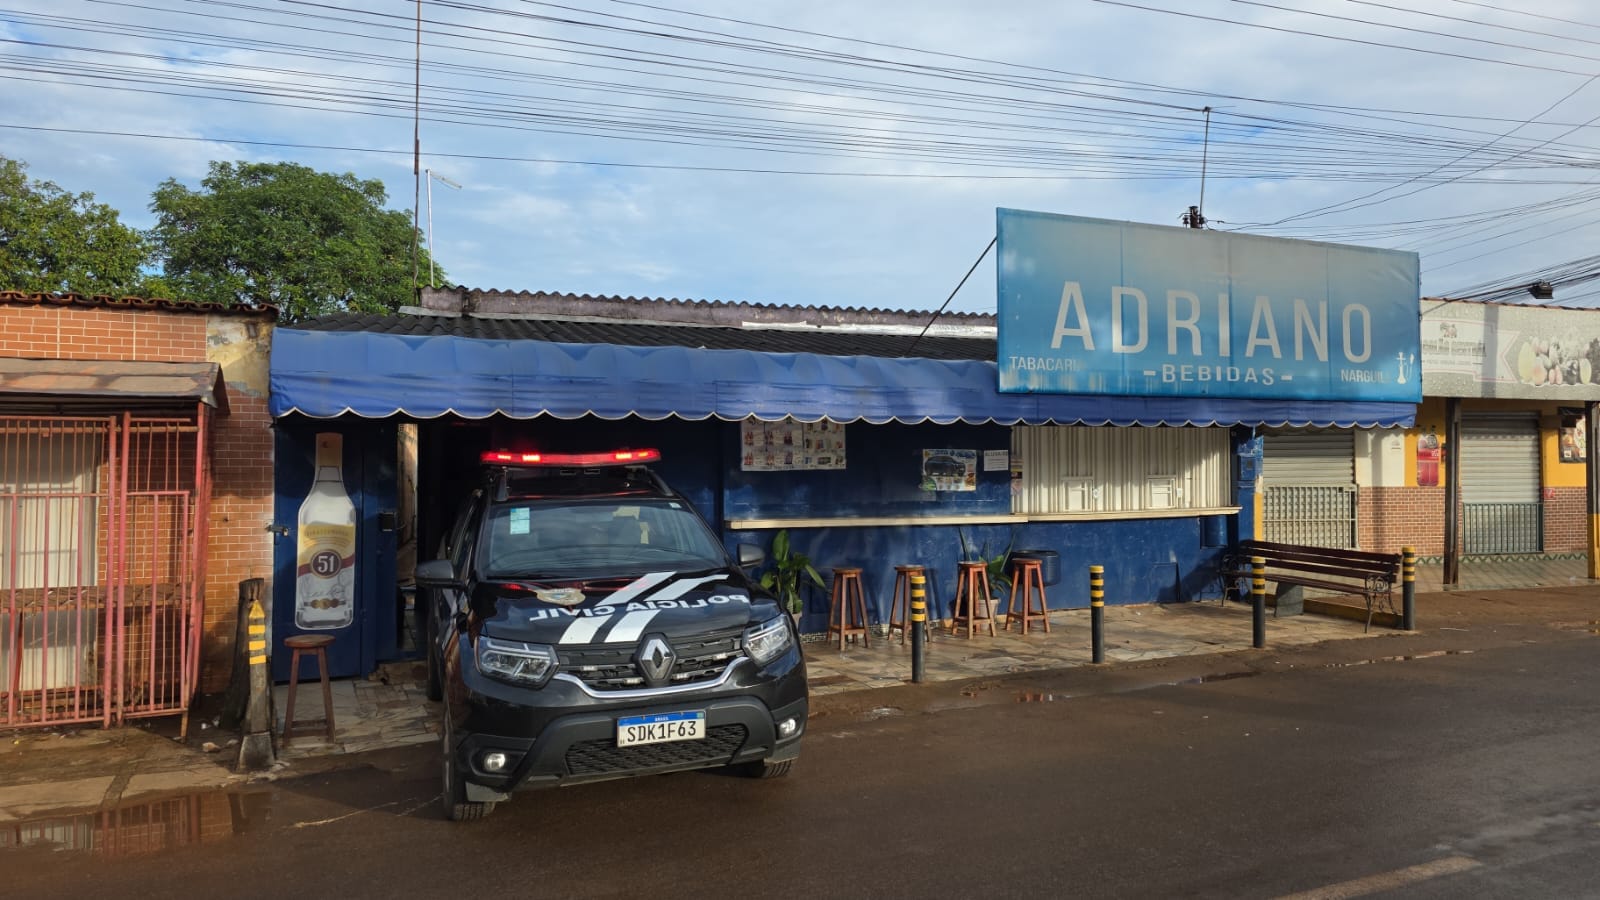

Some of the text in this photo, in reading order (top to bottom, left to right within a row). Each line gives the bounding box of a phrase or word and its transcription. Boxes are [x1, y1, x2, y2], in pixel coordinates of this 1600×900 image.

[1050, 280, 1372, 363] ADRIANO
[317, 555, 335, 573] 51
[627, 720, 697, 743] SDK1F63
